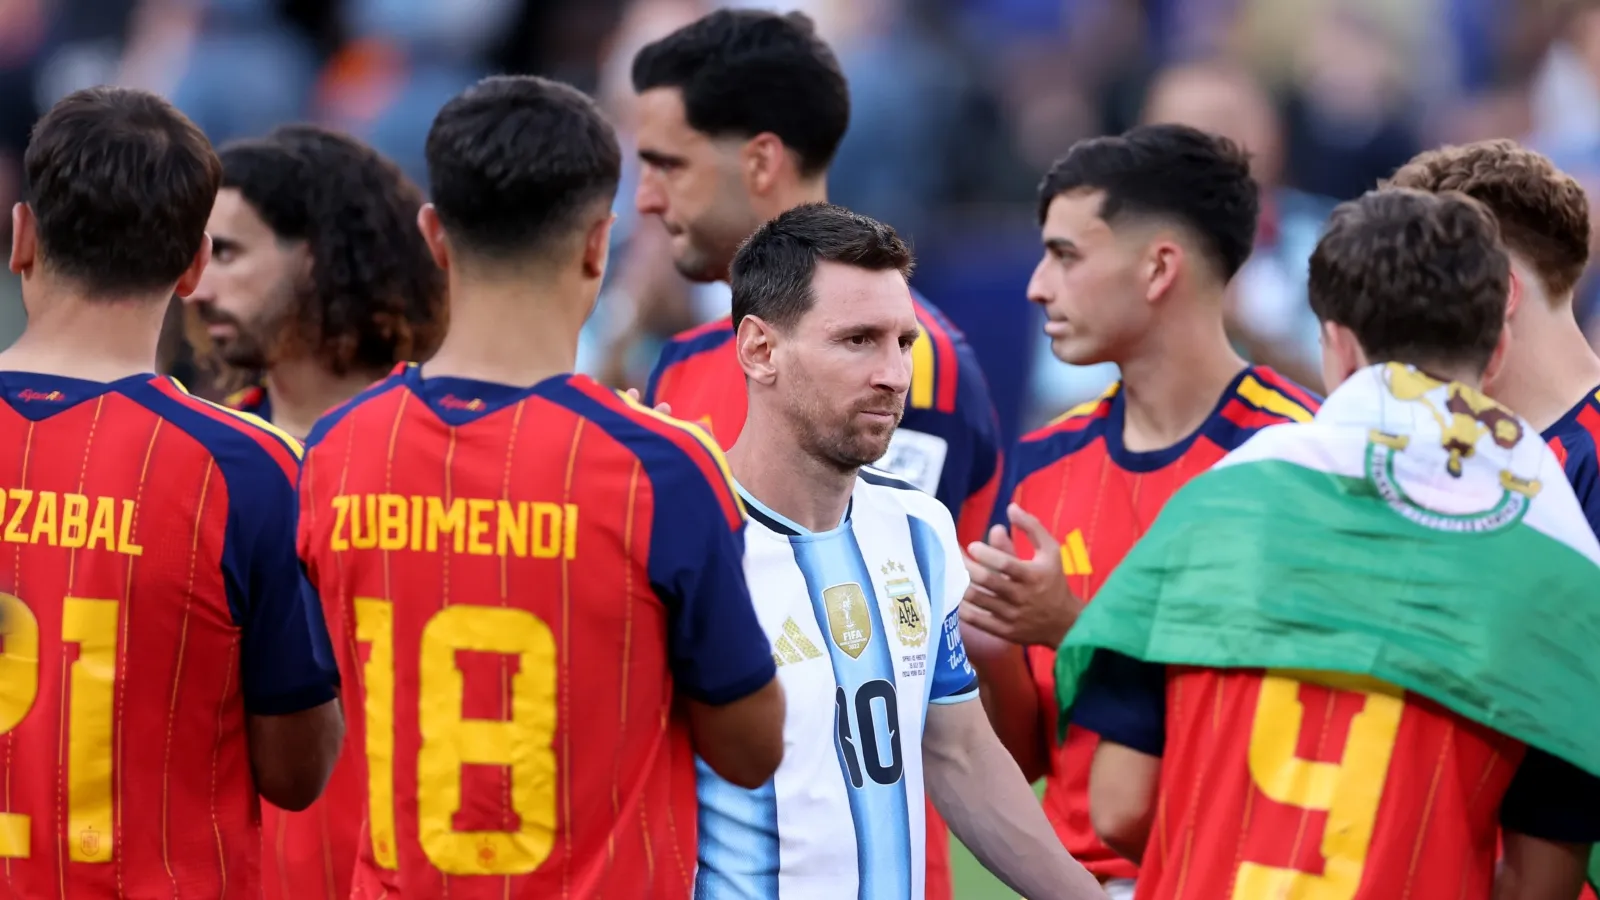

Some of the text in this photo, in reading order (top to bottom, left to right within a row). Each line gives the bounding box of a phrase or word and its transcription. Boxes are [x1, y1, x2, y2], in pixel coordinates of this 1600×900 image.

[330, 493, 580, 559] ZUBIMENDI
[843, 630, 863, 641] FIFA
[896, 596, 920, 628] AFA
[353, 597, 557, 876] 18
[836, 678, 903, 789] 10
[1230, 668, 1406, 900] 9
